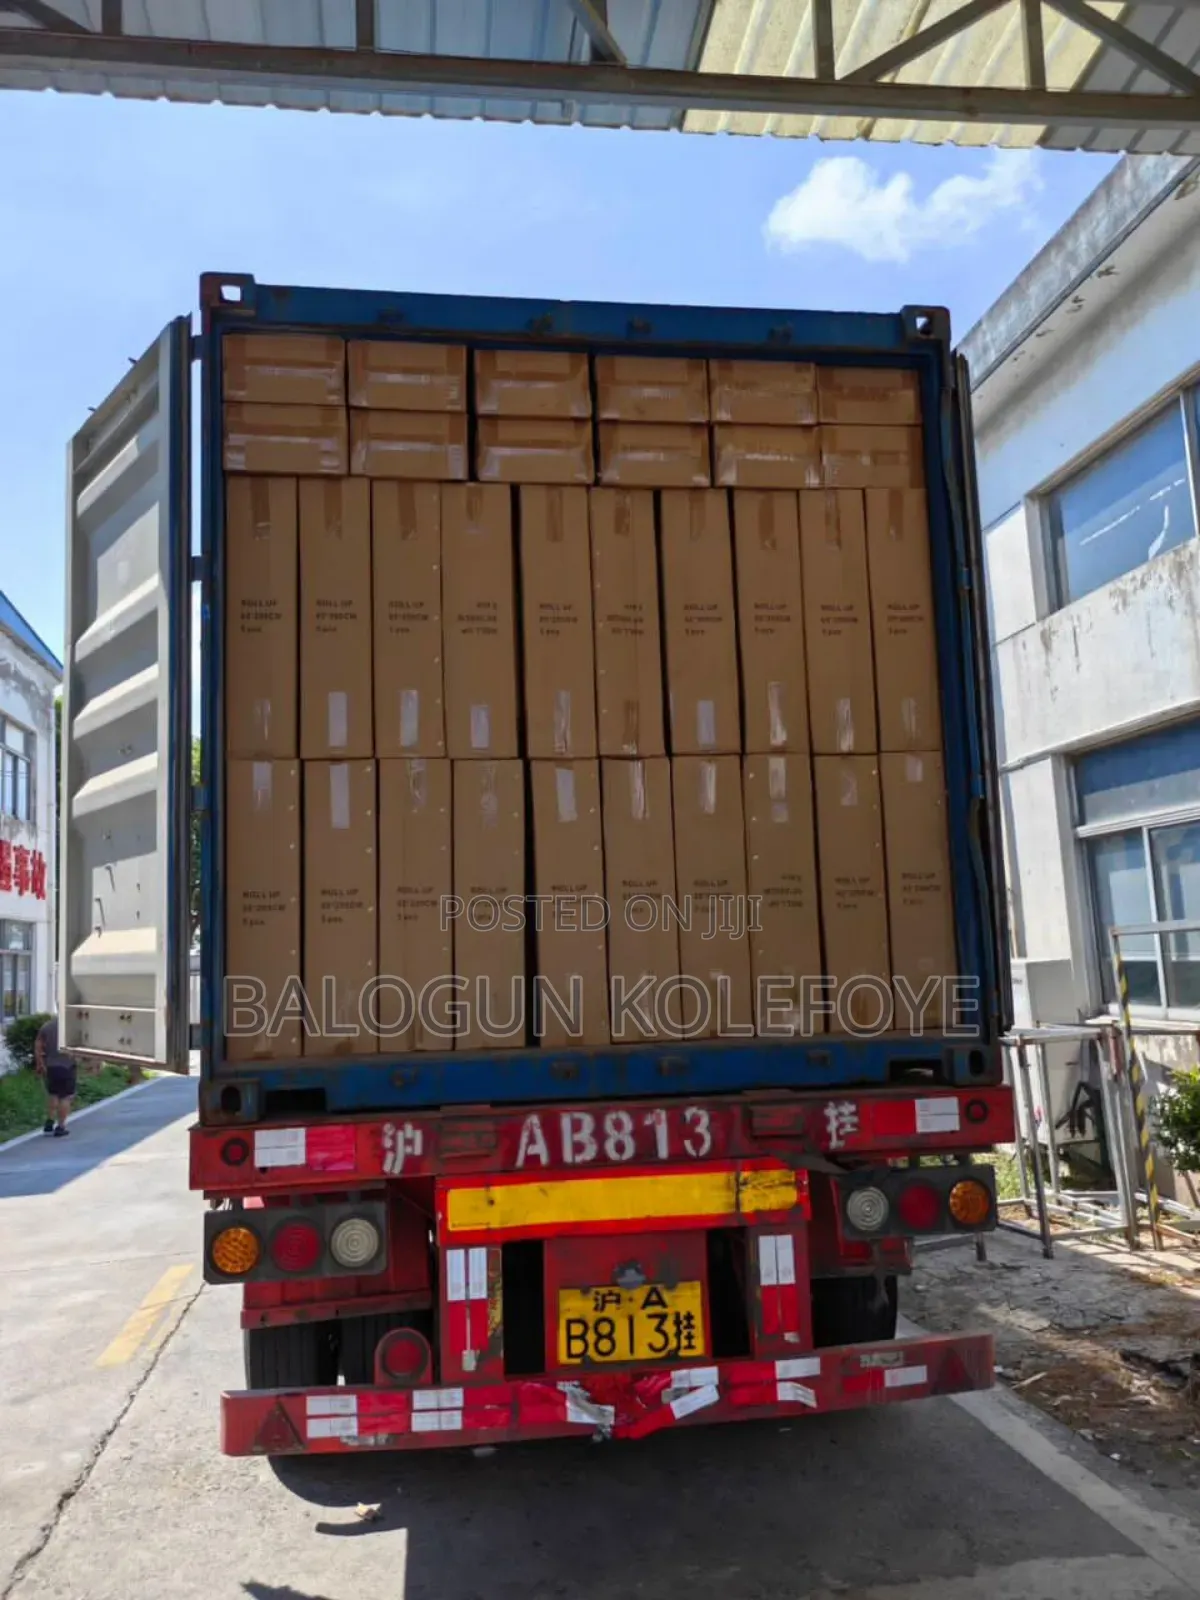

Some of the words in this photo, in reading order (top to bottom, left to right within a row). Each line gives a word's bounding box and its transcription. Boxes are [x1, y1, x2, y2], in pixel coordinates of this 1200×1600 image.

[382, 1122, 422, 1174] 沪
[515, 1107, 711, 1168] AB813
[824, 1102, 859, 1149] 挂
[566, 1311, 696, 1359] B813挂
